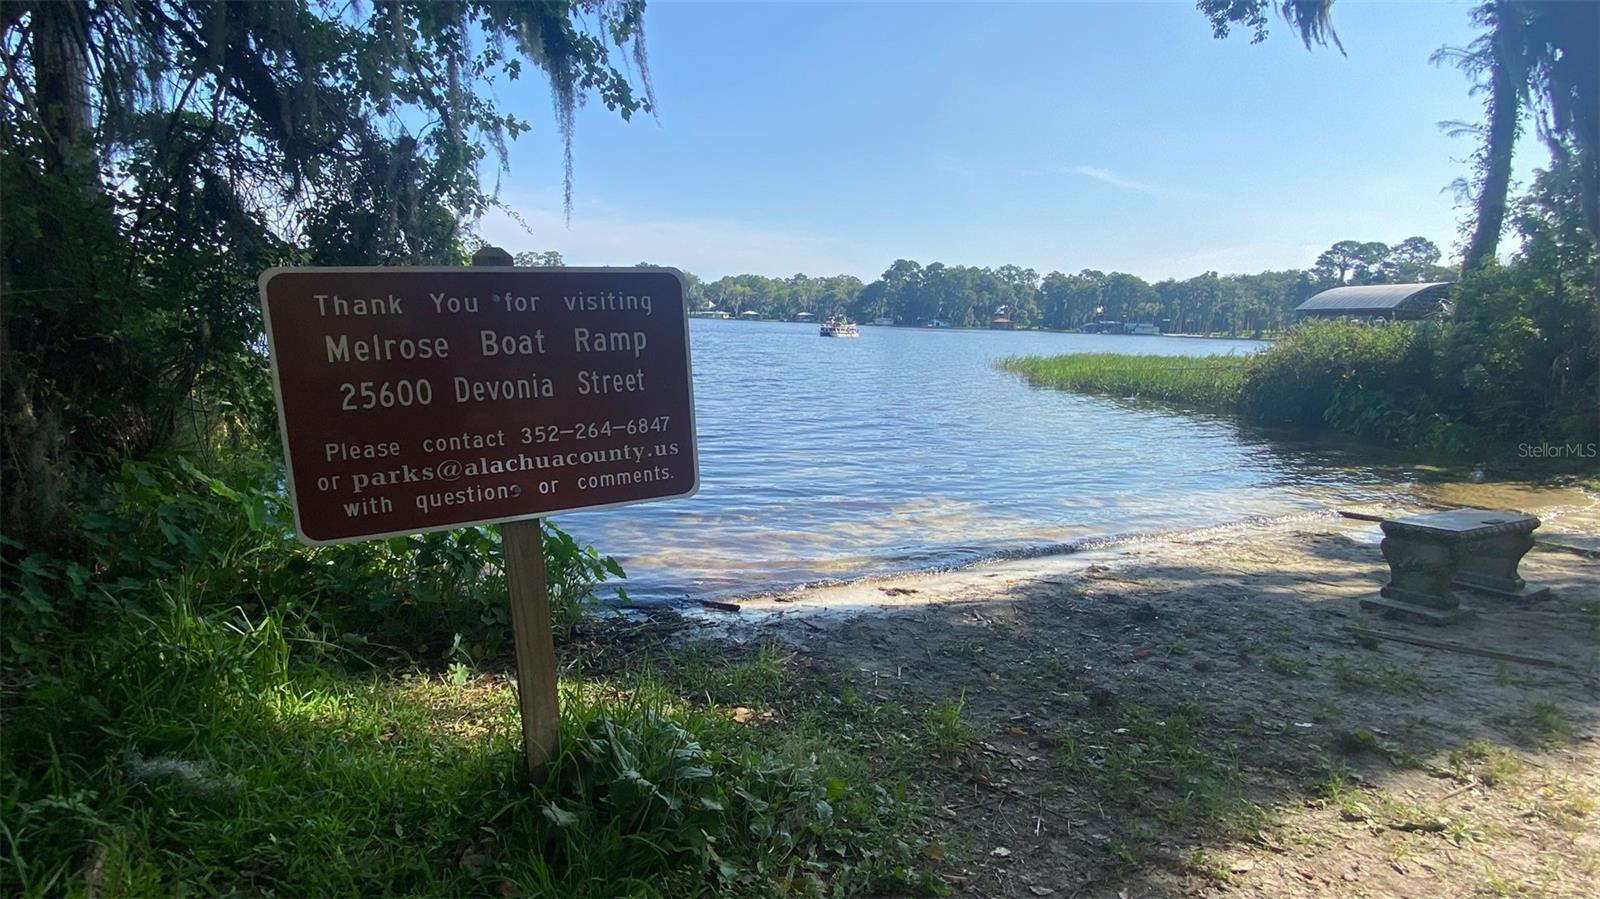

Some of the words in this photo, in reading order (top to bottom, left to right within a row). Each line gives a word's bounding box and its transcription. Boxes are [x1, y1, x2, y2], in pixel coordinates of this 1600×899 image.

[314, 295, 402, 315] Thank
[430, 293, 478, 312] You
[505, 293, 539, 311] for
[564, 292, 651, 315] visiting
[326, 335, 448, 362] Melrose
[481, 330, 545, 355] Boat
[575, 328, 646, 357] Ramp
[340, 379, 432, 410] 25600
[455, 373, 553, 402] Devonia
[579, 369, 644, 394] Street
[326, 443, 399, 461] Please
[423, 430, 504, 452] contact
[521, 416, 669, 443] 352-264-6847
[318, 476, 340, 490] or
[352, 441, 680, 493] parks@alachuacounty.us
[344, 496, 392, 516] with
[539, 480, 558, 494] or
[578, 466, 673, 489] comments.
